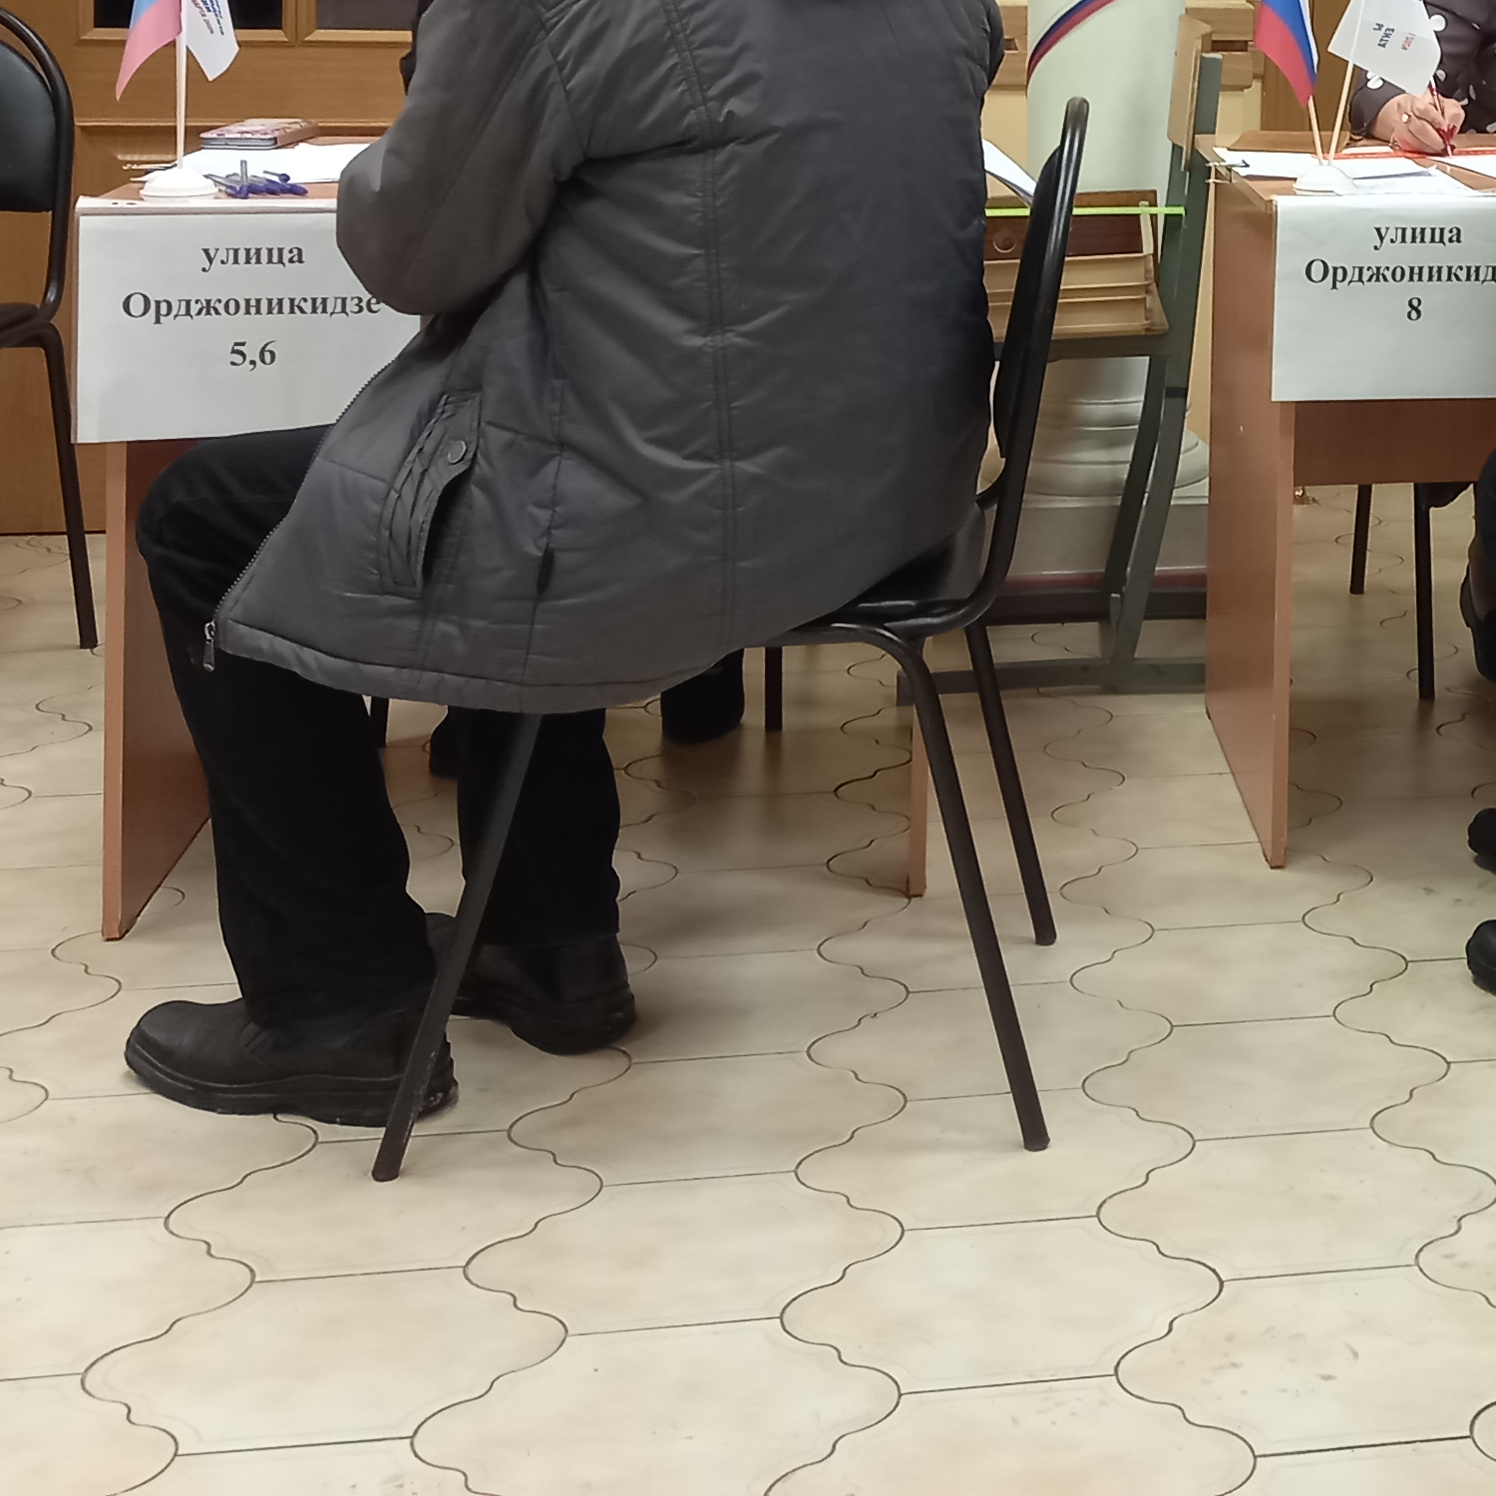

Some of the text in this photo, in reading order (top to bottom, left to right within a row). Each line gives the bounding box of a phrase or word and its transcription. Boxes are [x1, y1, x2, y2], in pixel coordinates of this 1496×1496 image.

[1373, 226, 1463, 251] улица
[200, 245, 305, 273] улица
[121, 292, 382, 324] Орджоникидзе
[1406, 296, 1422, 322] 8
[228, 340, 277, 372] 5,6
